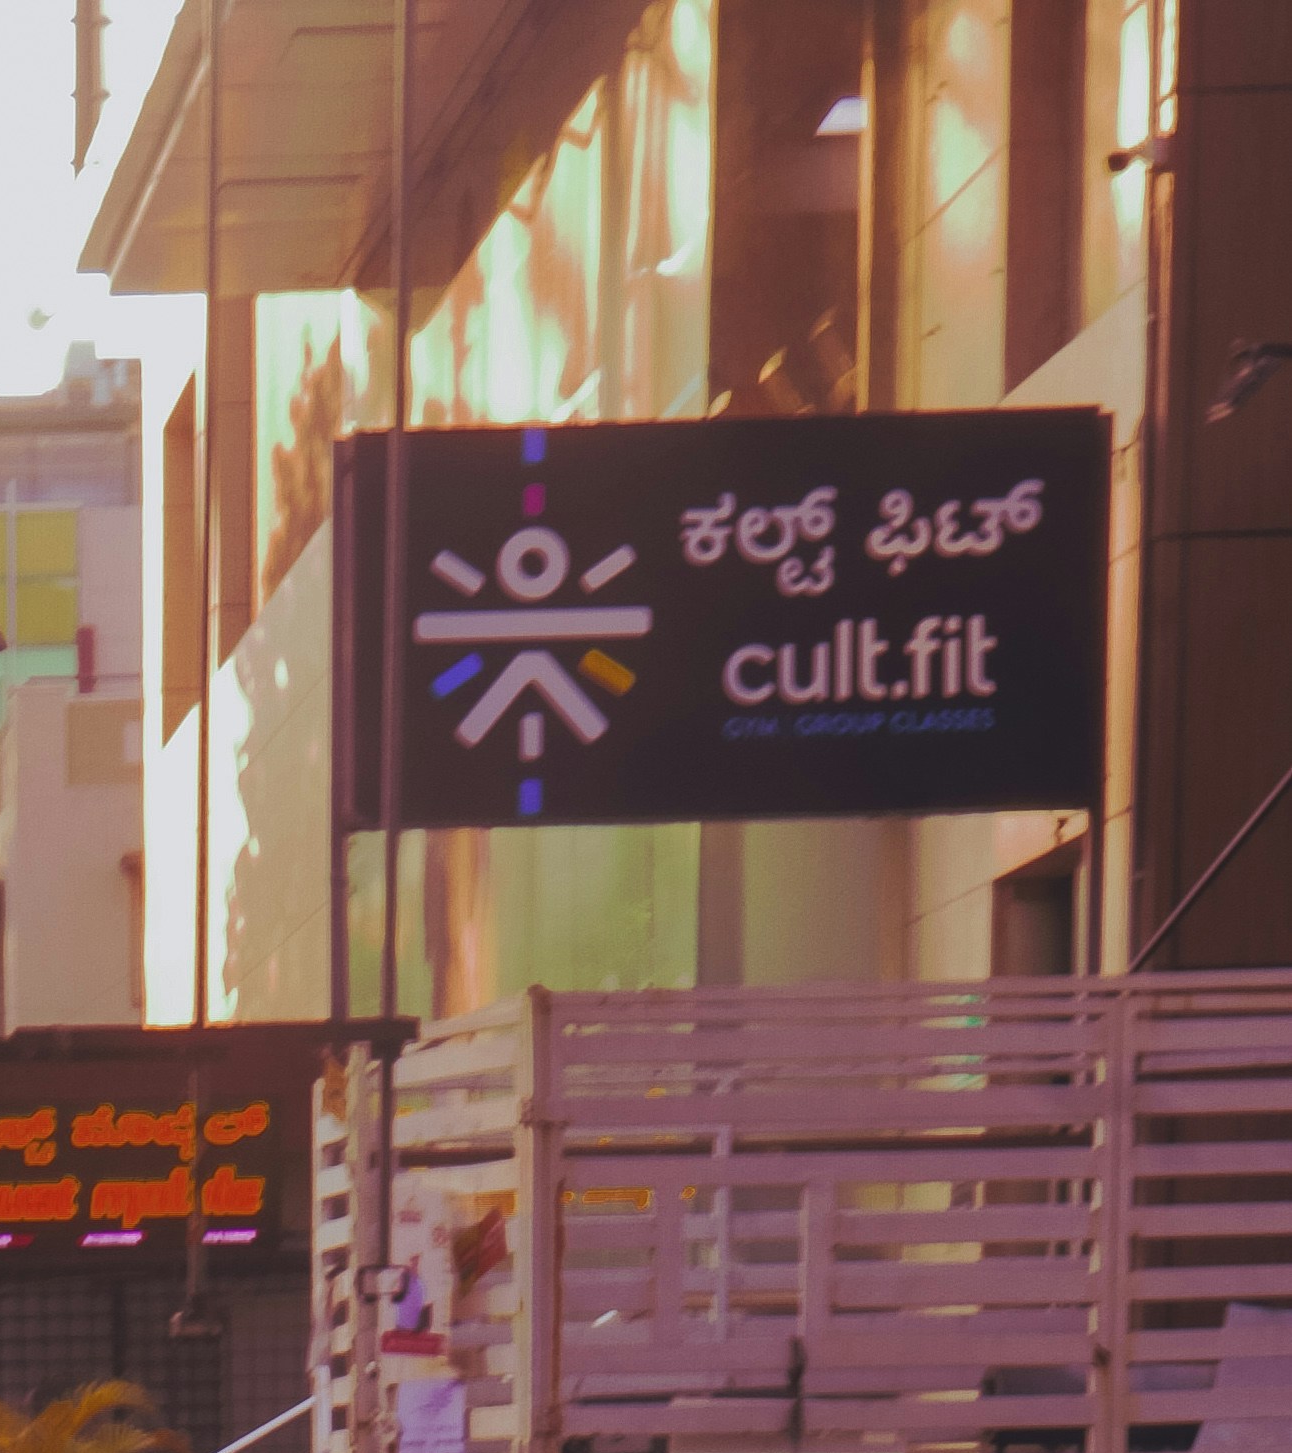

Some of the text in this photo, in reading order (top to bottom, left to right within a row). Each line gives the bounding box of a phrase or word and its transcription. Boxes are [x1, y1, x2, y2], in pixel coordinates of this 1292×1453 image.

[722, 613, 998, 706] cult.fit
[794, 711, 885, 735] GROUP
[889, 707, 996, 733] CLASSES
